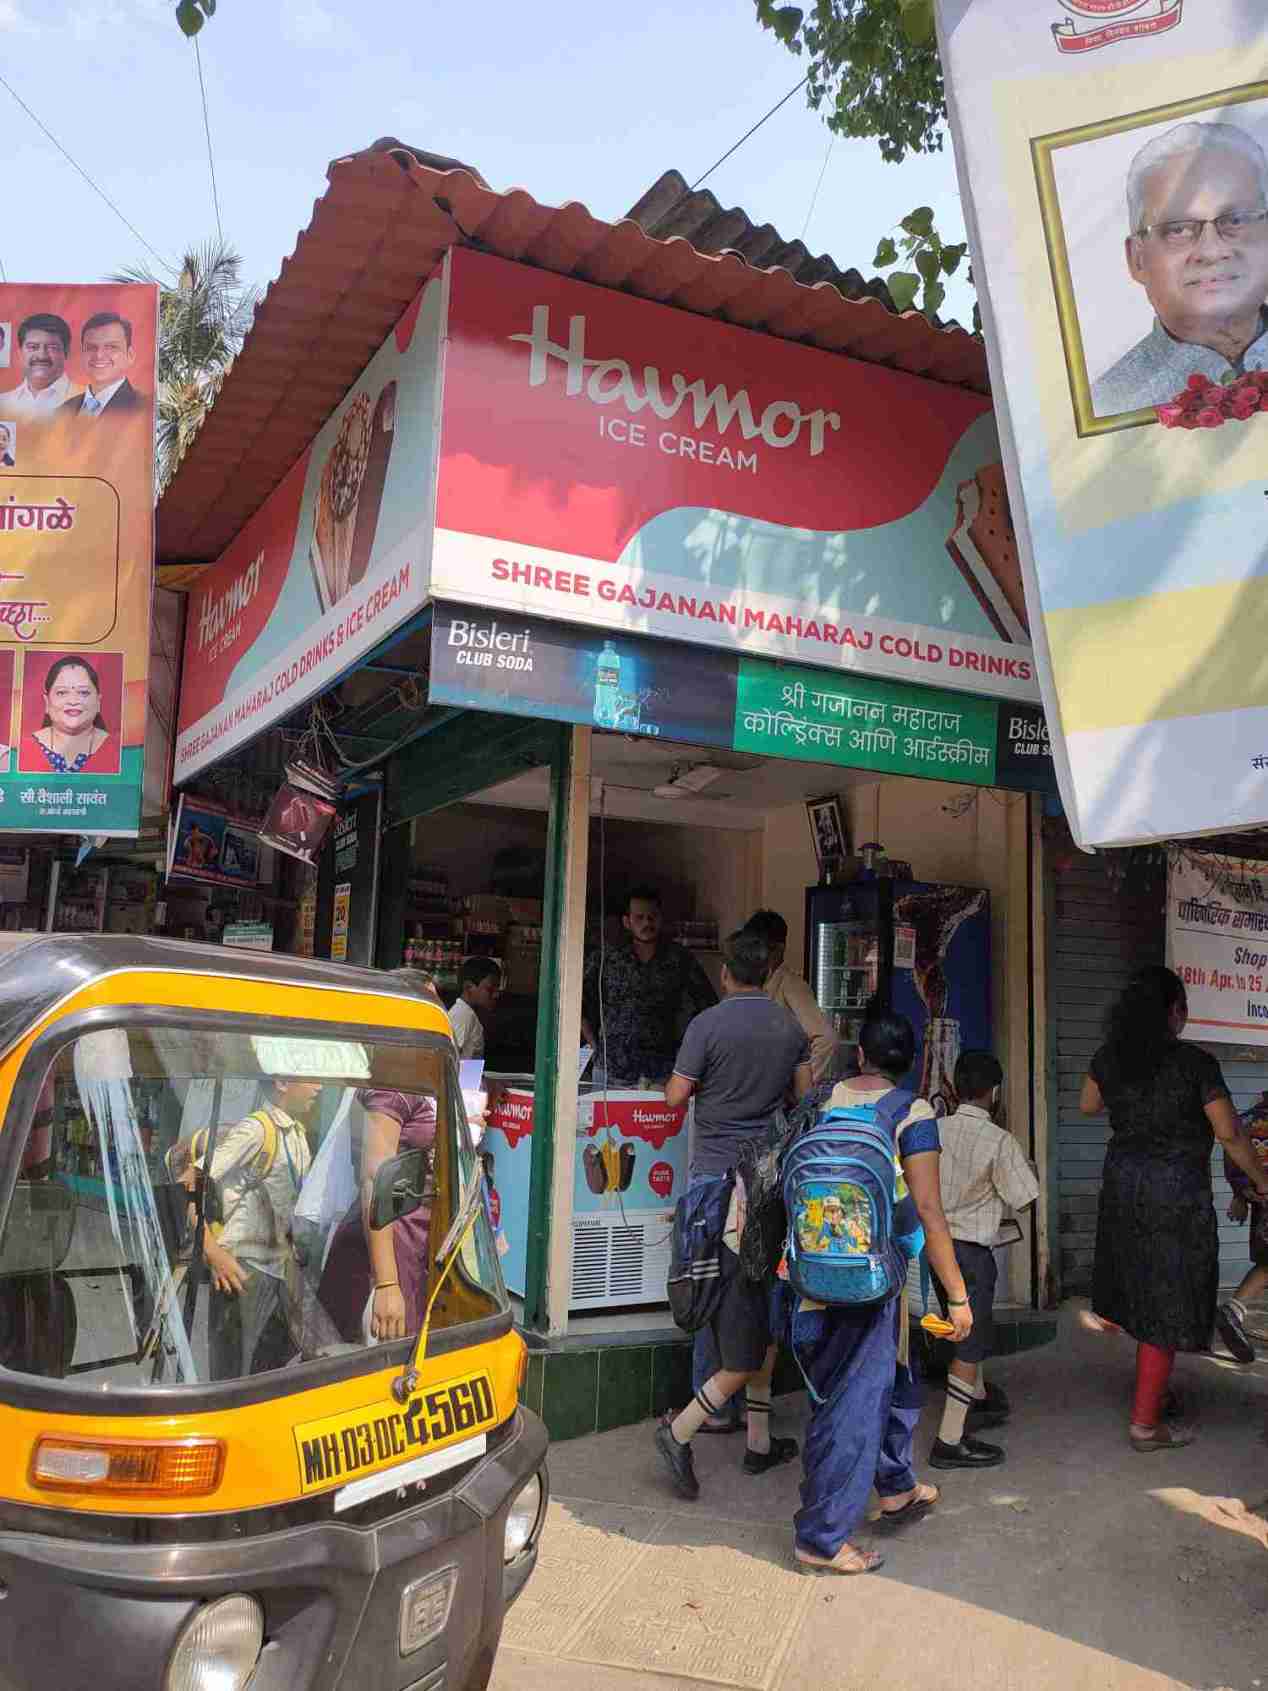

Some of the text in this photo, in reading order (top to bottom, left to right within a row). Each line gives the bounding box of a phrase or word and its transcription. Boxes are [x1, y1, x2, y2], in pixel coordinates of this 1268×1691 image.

[507, 305, 840, 456] Havmor
[599, 415, 758, 474] ICE CREAM
[197, 550, 265, 652] Havmor
[447, 619, 531, 653] Bisleri
[490, 558, 1032, 681] SHREE GAJANAN MAHARAJ COLD DRINKS
[180, 561, 411, 763] SHREE GAJANAN MAHARAJ COLD DRINKS & ICE CREAM
[456, 650, 534, 673] CLUB SODA
[781, 681, 963, 734] श्री गजानन महाराज
[848, 727, 899, 756] आणि
[1014, 742, 1040, 755] CLUB
[1233, 946, 1268, 971] Shop
[1248, 973, 1263, 992] 25
[632, 1107, 679, 1122] Havmor
